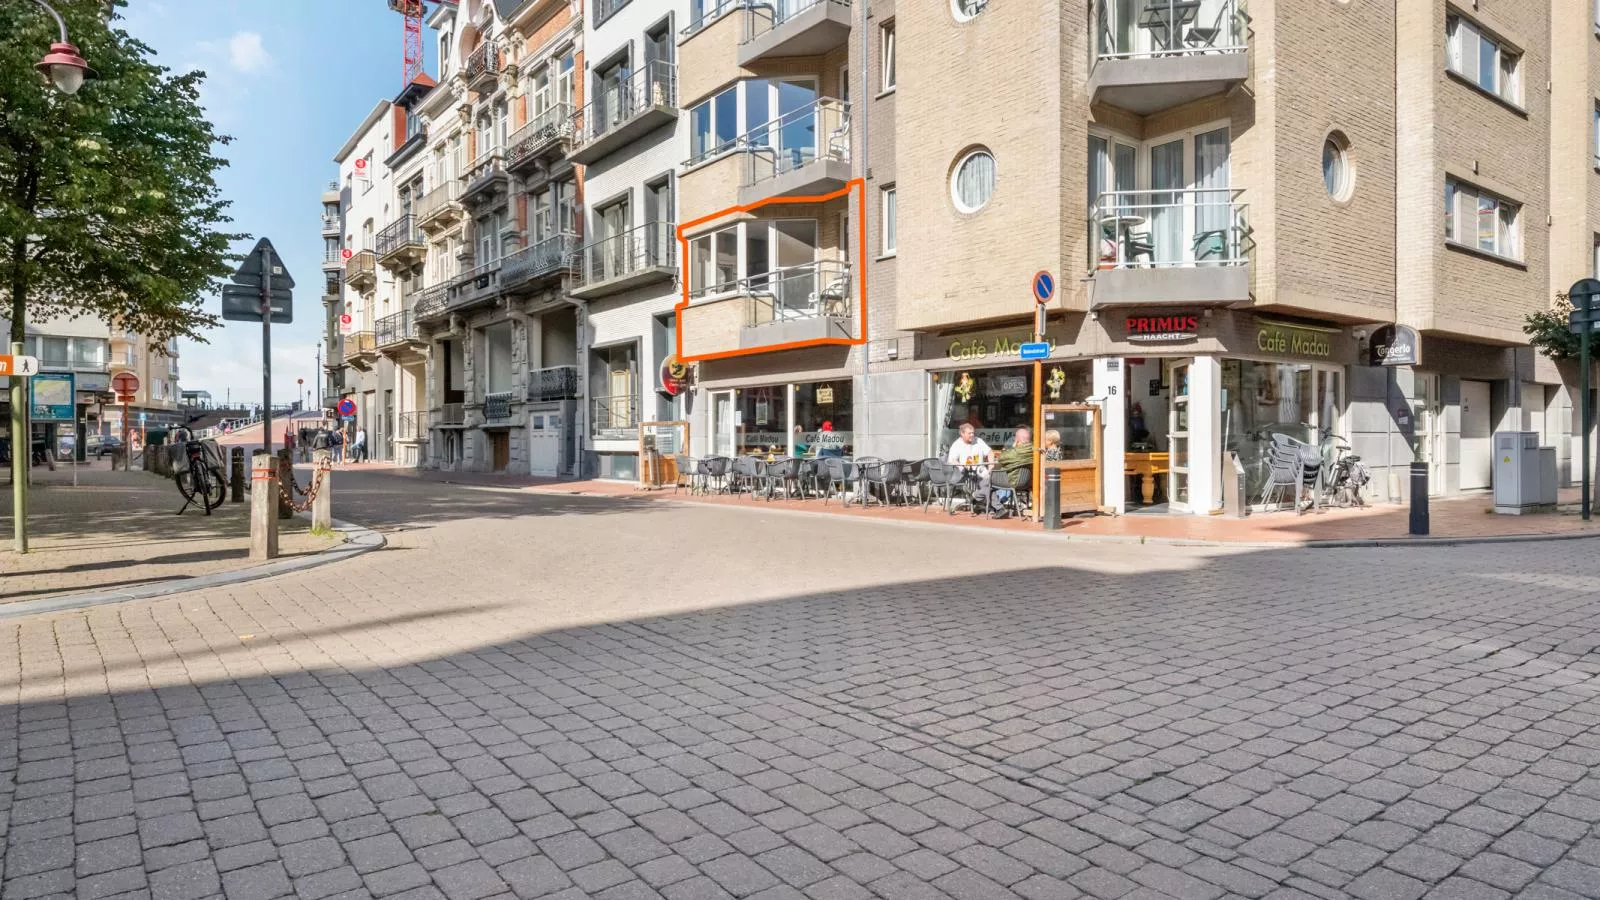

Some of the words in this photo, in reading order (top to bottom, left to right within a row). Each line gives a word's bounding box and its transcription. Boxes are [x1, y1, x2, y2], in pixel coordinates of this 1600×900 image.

[1126, 316, 1198, 334] PRIMUS
[1143, 333, 1181, 341] HAACHT
[1257, 329, 1286, 353] Café
[949, 339, 987, 361] Café
[1107, 385, 1117, 396] 16
[805, 433, 821, 444] Café
[822, 434, 844, 443] Madou
